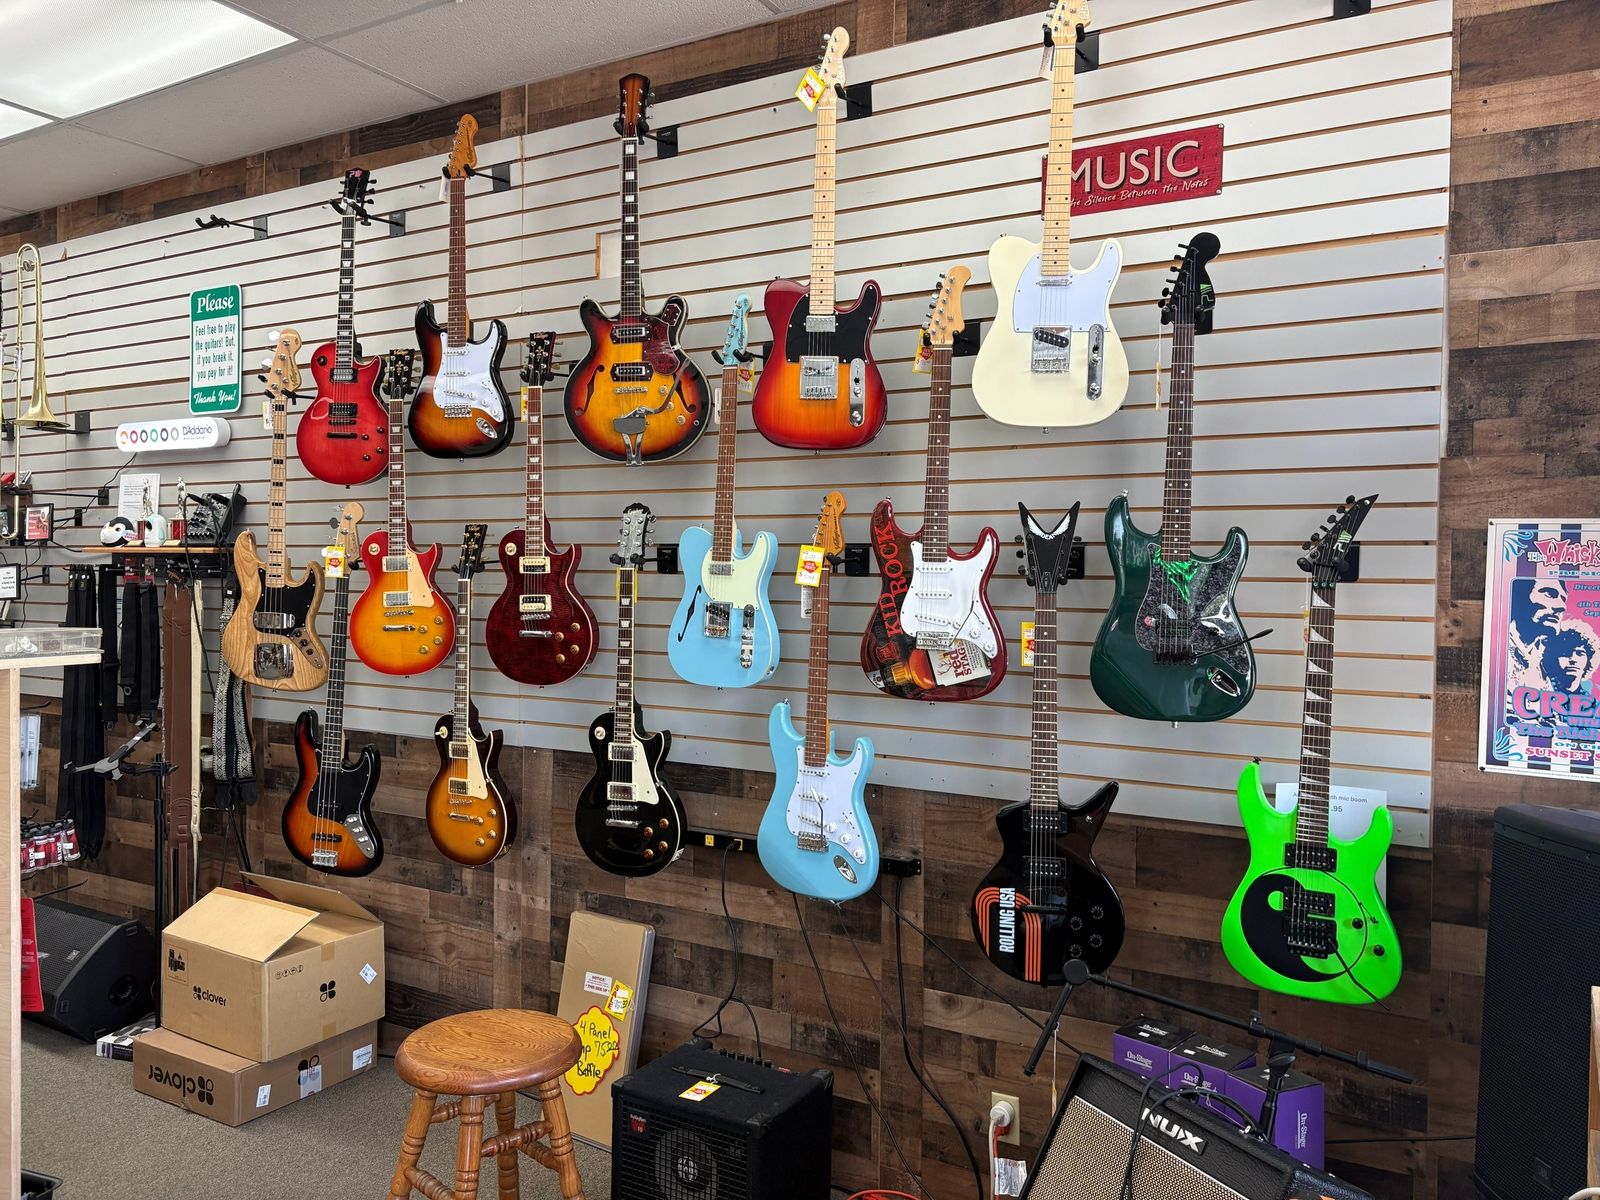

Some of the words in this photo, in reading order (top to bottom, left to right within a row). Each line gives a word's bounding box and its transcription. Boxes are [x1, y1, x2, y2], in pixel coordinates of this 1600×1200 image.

[1071, 140, 1199, 192] MUSIC
[1084, 194, 1117, 207] Silence
[1120, 188, 1158, 201] Between
[1162, 184, 1178, 194] the
[1182, 178, 1210, 191] Notes
[196, 293, 235, 313] Please
[195, 325, 206, 336] Feel
[207, 323, 217, 335] free
[218, 323, 224, 333] to
[225, 322, 236, 334] play
[195, 340, 204, 351] the
[204, 337, 224, 352] guitars!
[196, 354, 201, 365] if
[202, 355, 211, 367] you
[212, 352, 227, 364] break
[197, 370, 206, 382] you
[207, 368, 217, 380] pay
[193, 390, 217, 405] Thank
[218, 389, 237, 405] You!
[874, 521, 909, 597] ROCK
[879, 593, 904, 638] KID
[943, 650, 964, 678] red
[957, 647, 972, 676] STAG
[1525, 747, 1591, 760] SUNSET
[1000, 887, 1015, 908] USA
[999, 909, 1015, 953] ROLLING
[202, 989, 227, 1006] clover
[580, 1020, 587, 1034] 4
[590, 1022, 612, 1040] Panel
[1127, 1050, 1153, 1066] On-Stage
[577, 1060, 601, 1079] Baffle
[148, 1065, 196, 1098] clover
[1141, 1107, 1204, 1153] NUX
[1300, 1112, 1308, 1149] On-Stage
